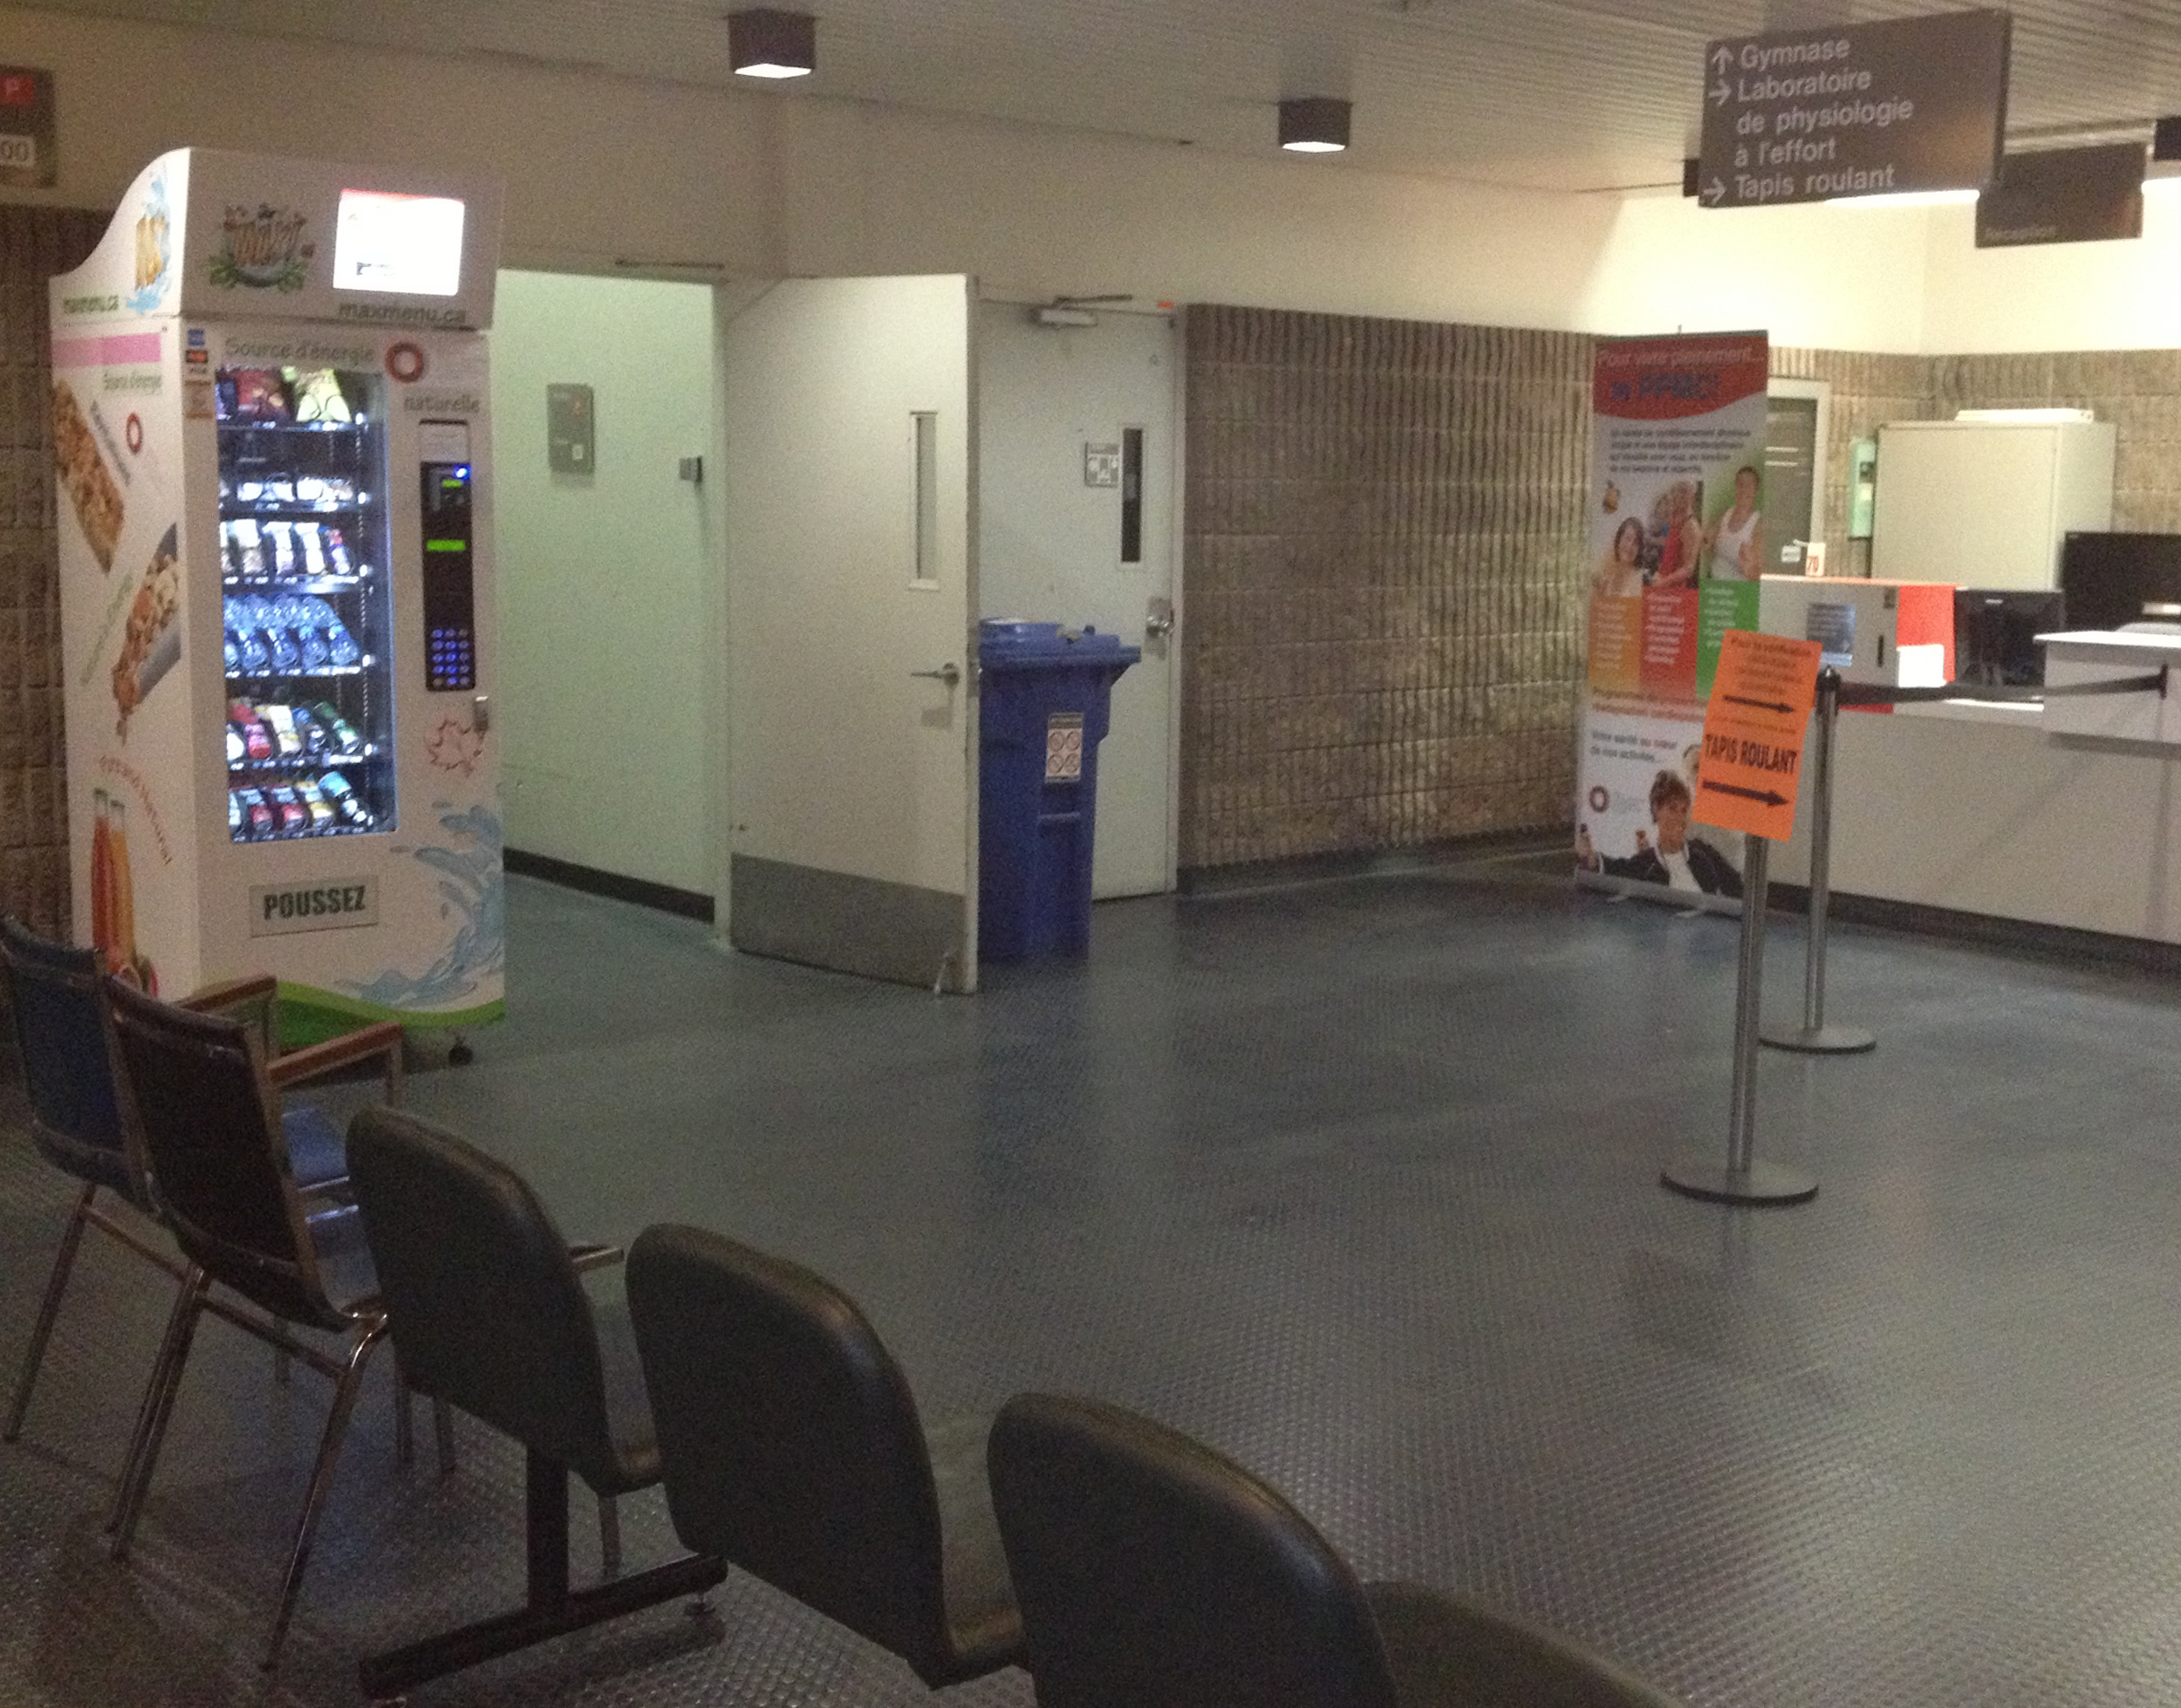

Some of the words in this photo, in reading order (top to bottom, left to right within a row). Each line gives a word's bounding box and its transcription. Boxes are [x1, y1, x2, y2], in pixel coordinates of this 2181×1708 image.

[1740, 38, 1850, 73] Gymnase
[1738, 70, 1872, 102] Laboratoire
[1736, 113, 1764, 135] de
[1775, 99, 1914, 134] physiologie
[1759, 137, 1837, 167] l'effort
[1735, 174, 1794, 201] Tapis
[1805, 164, 1895, 193] roulant
[338, 302, 467, 323] maxmenu.ca
[225, 336, 291, 358] Source
[404, 392, 481, 413] naturelle
[1704, 731, 1738, 765] TAPIS
[1740, 740, 1798, 774] ROULANT
[263, 884, 366, 920] POUSSEZ
